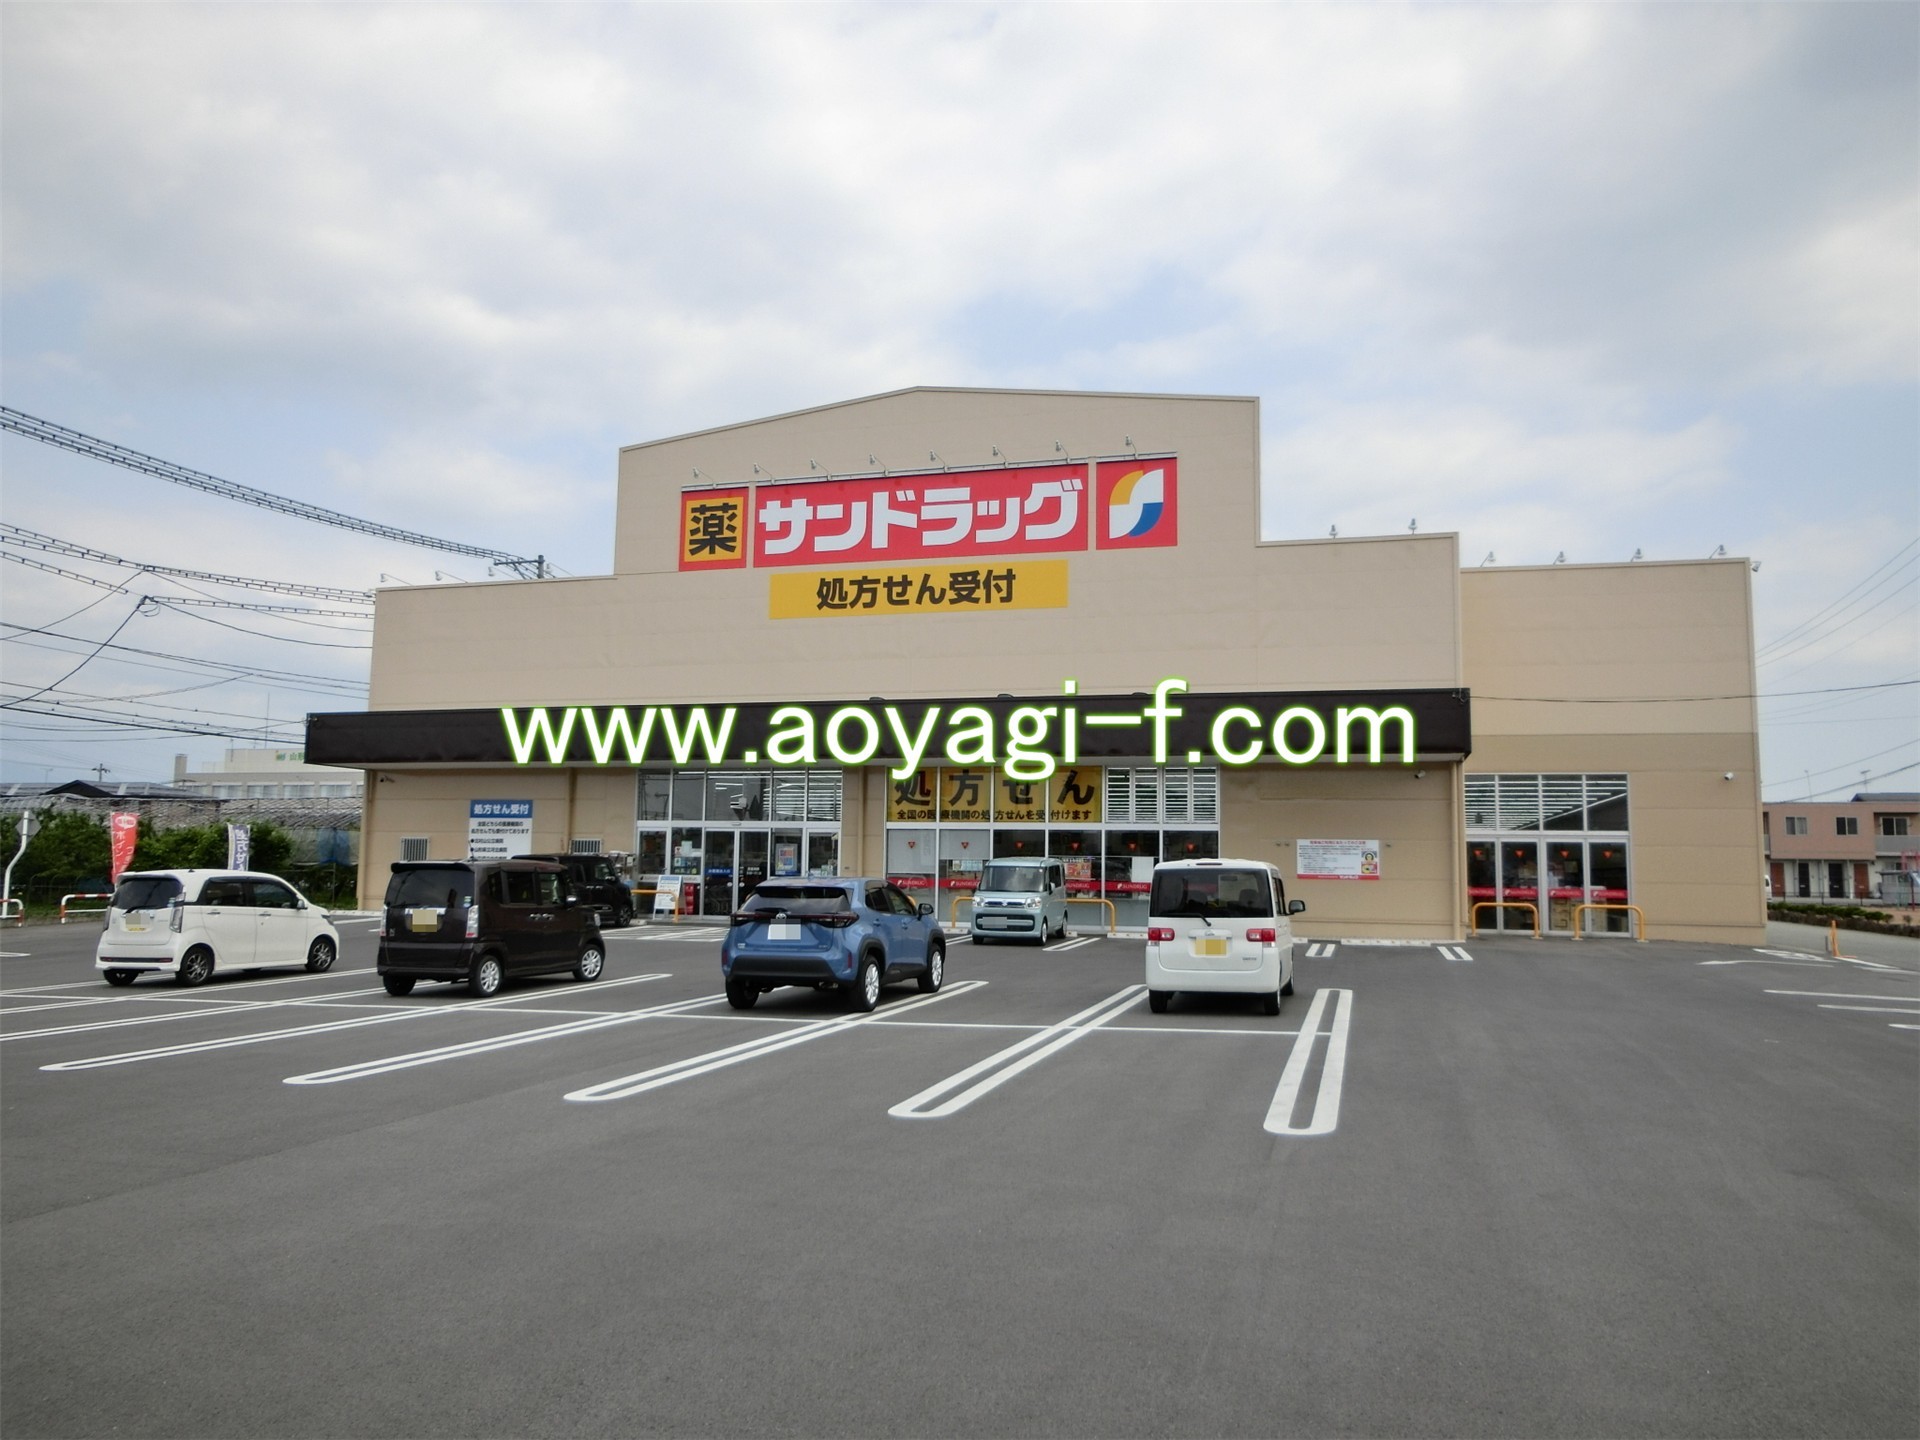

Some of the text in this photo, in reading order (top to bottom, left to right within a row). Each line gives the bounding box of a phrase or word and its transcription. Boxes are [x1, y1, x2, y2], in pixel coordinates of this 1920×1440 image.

[689, 503, 738, 556] 薬
[758, 478, 1083, 555] サンドラッグ
[816, 568, 1016, 611] 処方せん受付
[473, 803, 530, 815] 処方せん受付
